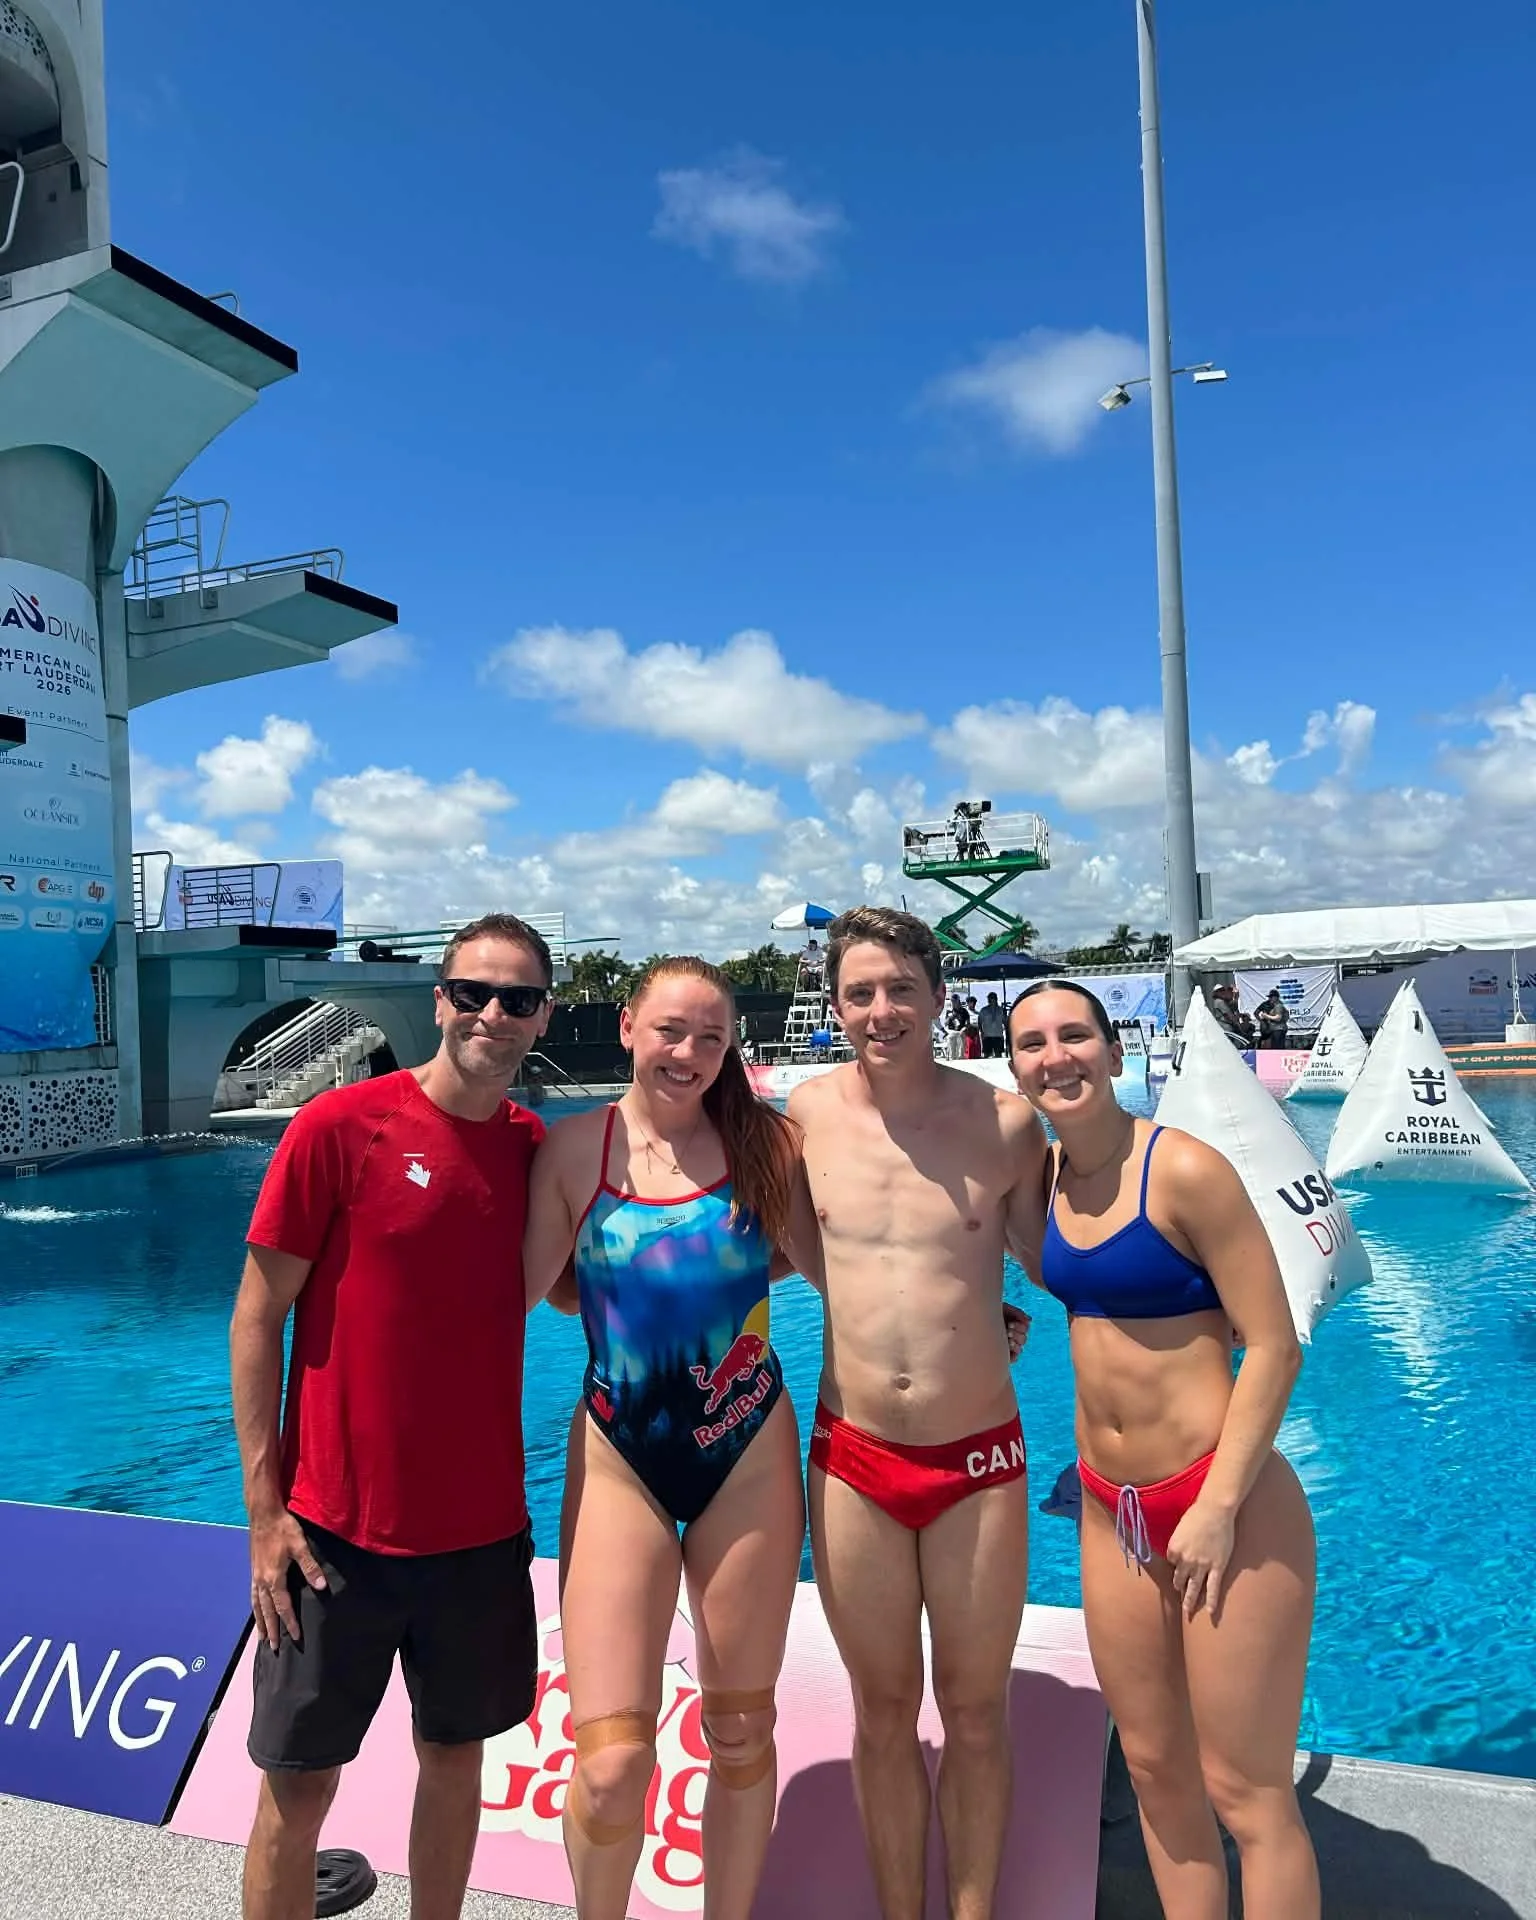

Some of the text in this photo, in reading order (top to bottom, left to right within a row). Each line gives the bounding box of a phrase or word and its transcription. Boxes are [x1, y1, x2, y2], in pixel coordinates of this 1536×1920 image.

[37, 679, 71, 695] 2026
[8, 705, 44, 719] Event
[10, 854, 60, 866] National
[234, 896, 273, 908] DIVNG
[1406, 1116, 1460, 1129] ROYAL
[1385, 1131, 1481, 1145] CARIBBEAN
[1397, 1148, 1473, 1157] ENTERTAINMENT
[1276, 1169, 1337, 1216] USA
[966, 1437, 1026, 1478] CAN
